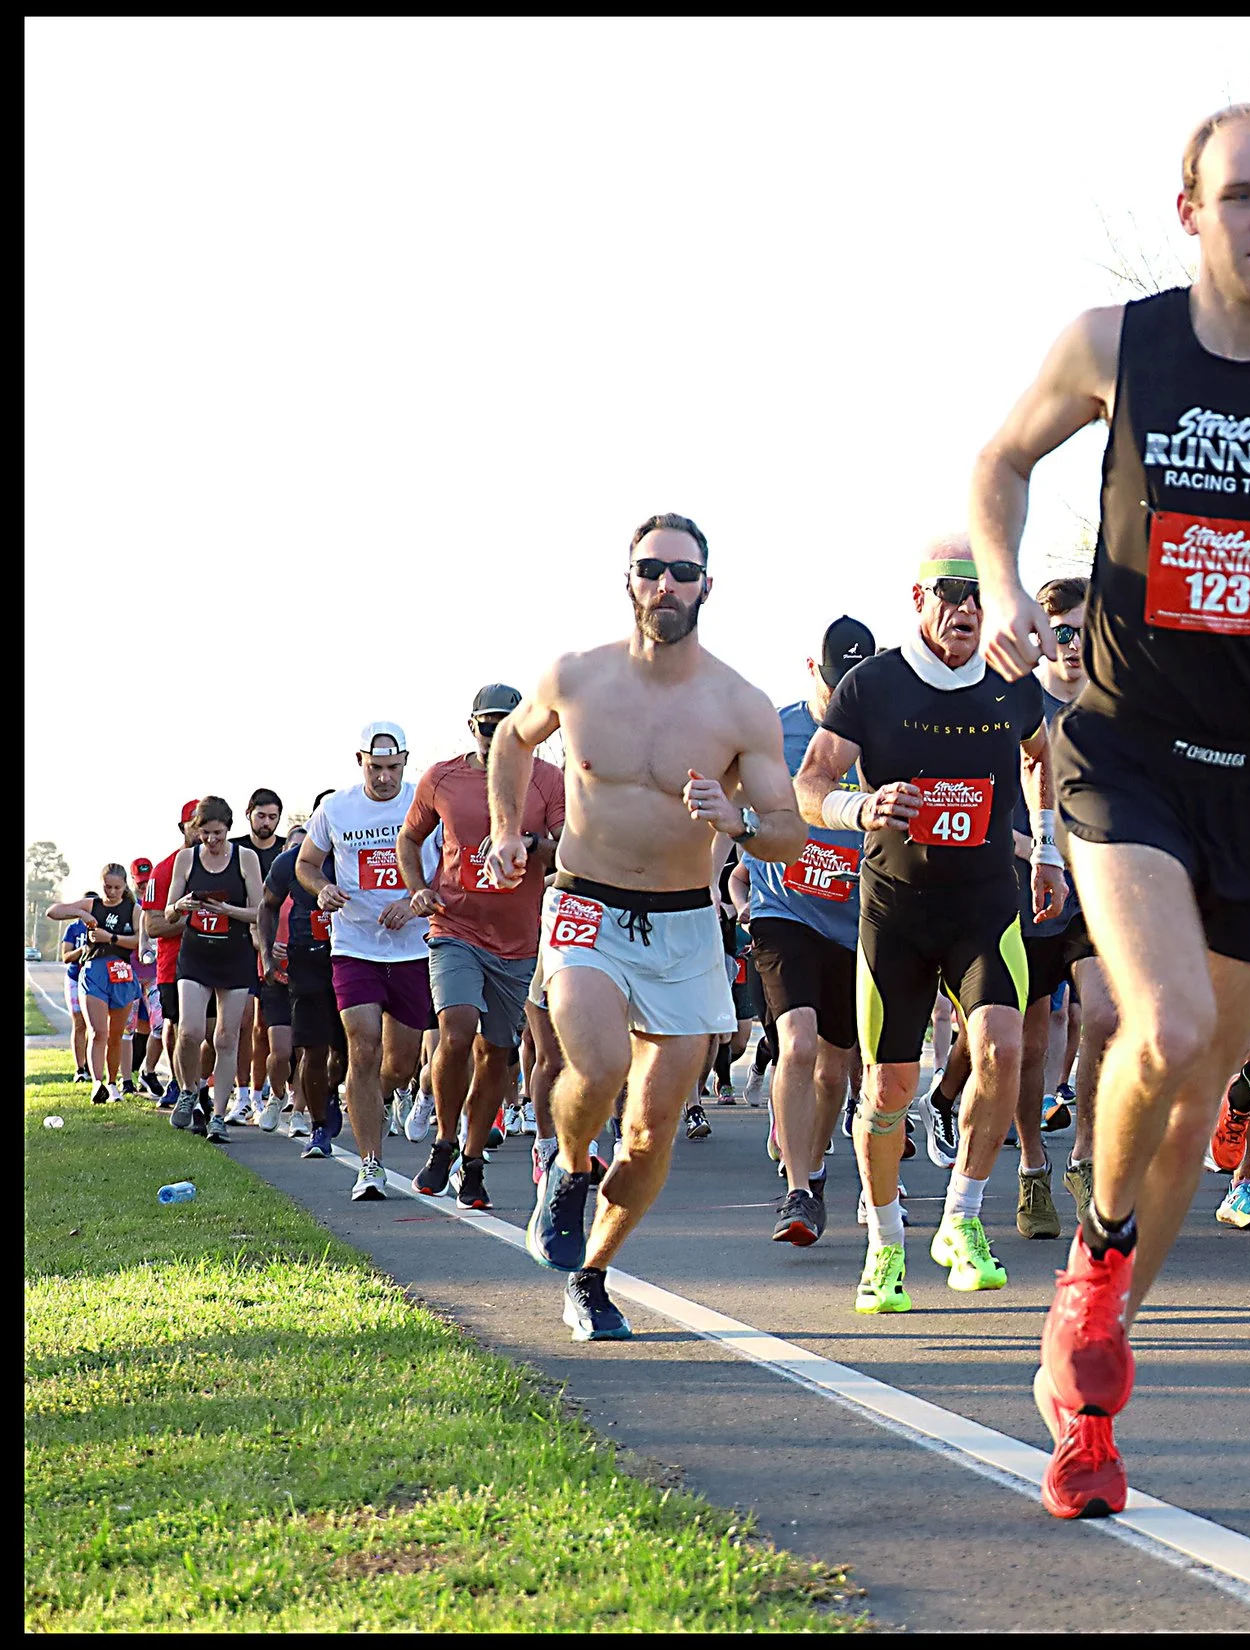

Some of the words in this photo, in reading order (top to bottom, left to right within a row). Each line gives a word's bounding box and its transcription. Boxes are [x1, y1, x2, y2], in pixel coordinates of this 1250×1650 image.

[1165, 470, 1236, 492] RACING
[904, 720, 1010, 734] LIVESTRONG
[933, 780, 975, 794] Strictly
[923, 788, 983, 804] RUNNING
[932, 811, 971, 841] 49
[366, 856, 399, 866] RUNNIN
[802, 843, 844, 862] Strictly
[373, 867, 398, 887] 73
[201, 917, 218, 931] 17
[555, 920, 597, 943] 62
